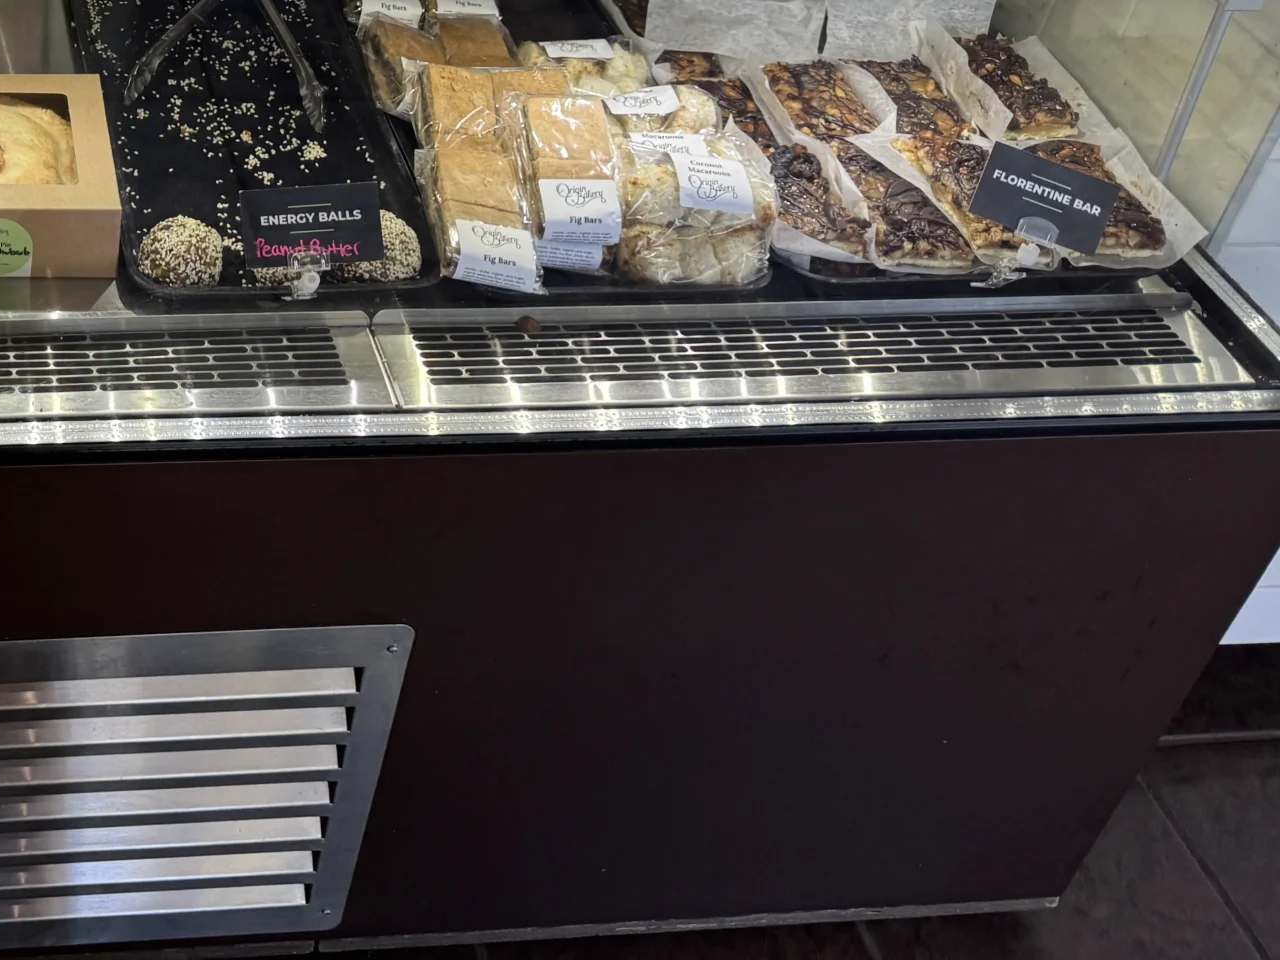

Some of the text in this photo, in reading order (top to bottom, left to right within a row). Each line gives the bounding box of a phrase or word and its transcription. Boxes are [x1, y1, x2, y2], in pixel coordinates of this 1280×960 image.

[380, 2, 408, 12] Fig Bars
[689, 160, 723, 169] Coconut
[688, 166, 732, 177] Macaroons
[688, 175, 719, 188] Origin
[556, 183, 587, 197] Origin
[697, 183, 738, 202] Bakery
[993, 169, 1101, 217] FLORENTINE BAR
[565, 188, 607, 208] Bakery
[260, 209, 362, 226] ENERGY BALLS
[569, 216, 602, 225] Fig Bars
[472, 225, 502, 238] Origin
[256, 237, 360, 257] Peanut Butter
[481, 233, 521, 249] Bakery
[483, 254, 517, 267] Fig Bars
